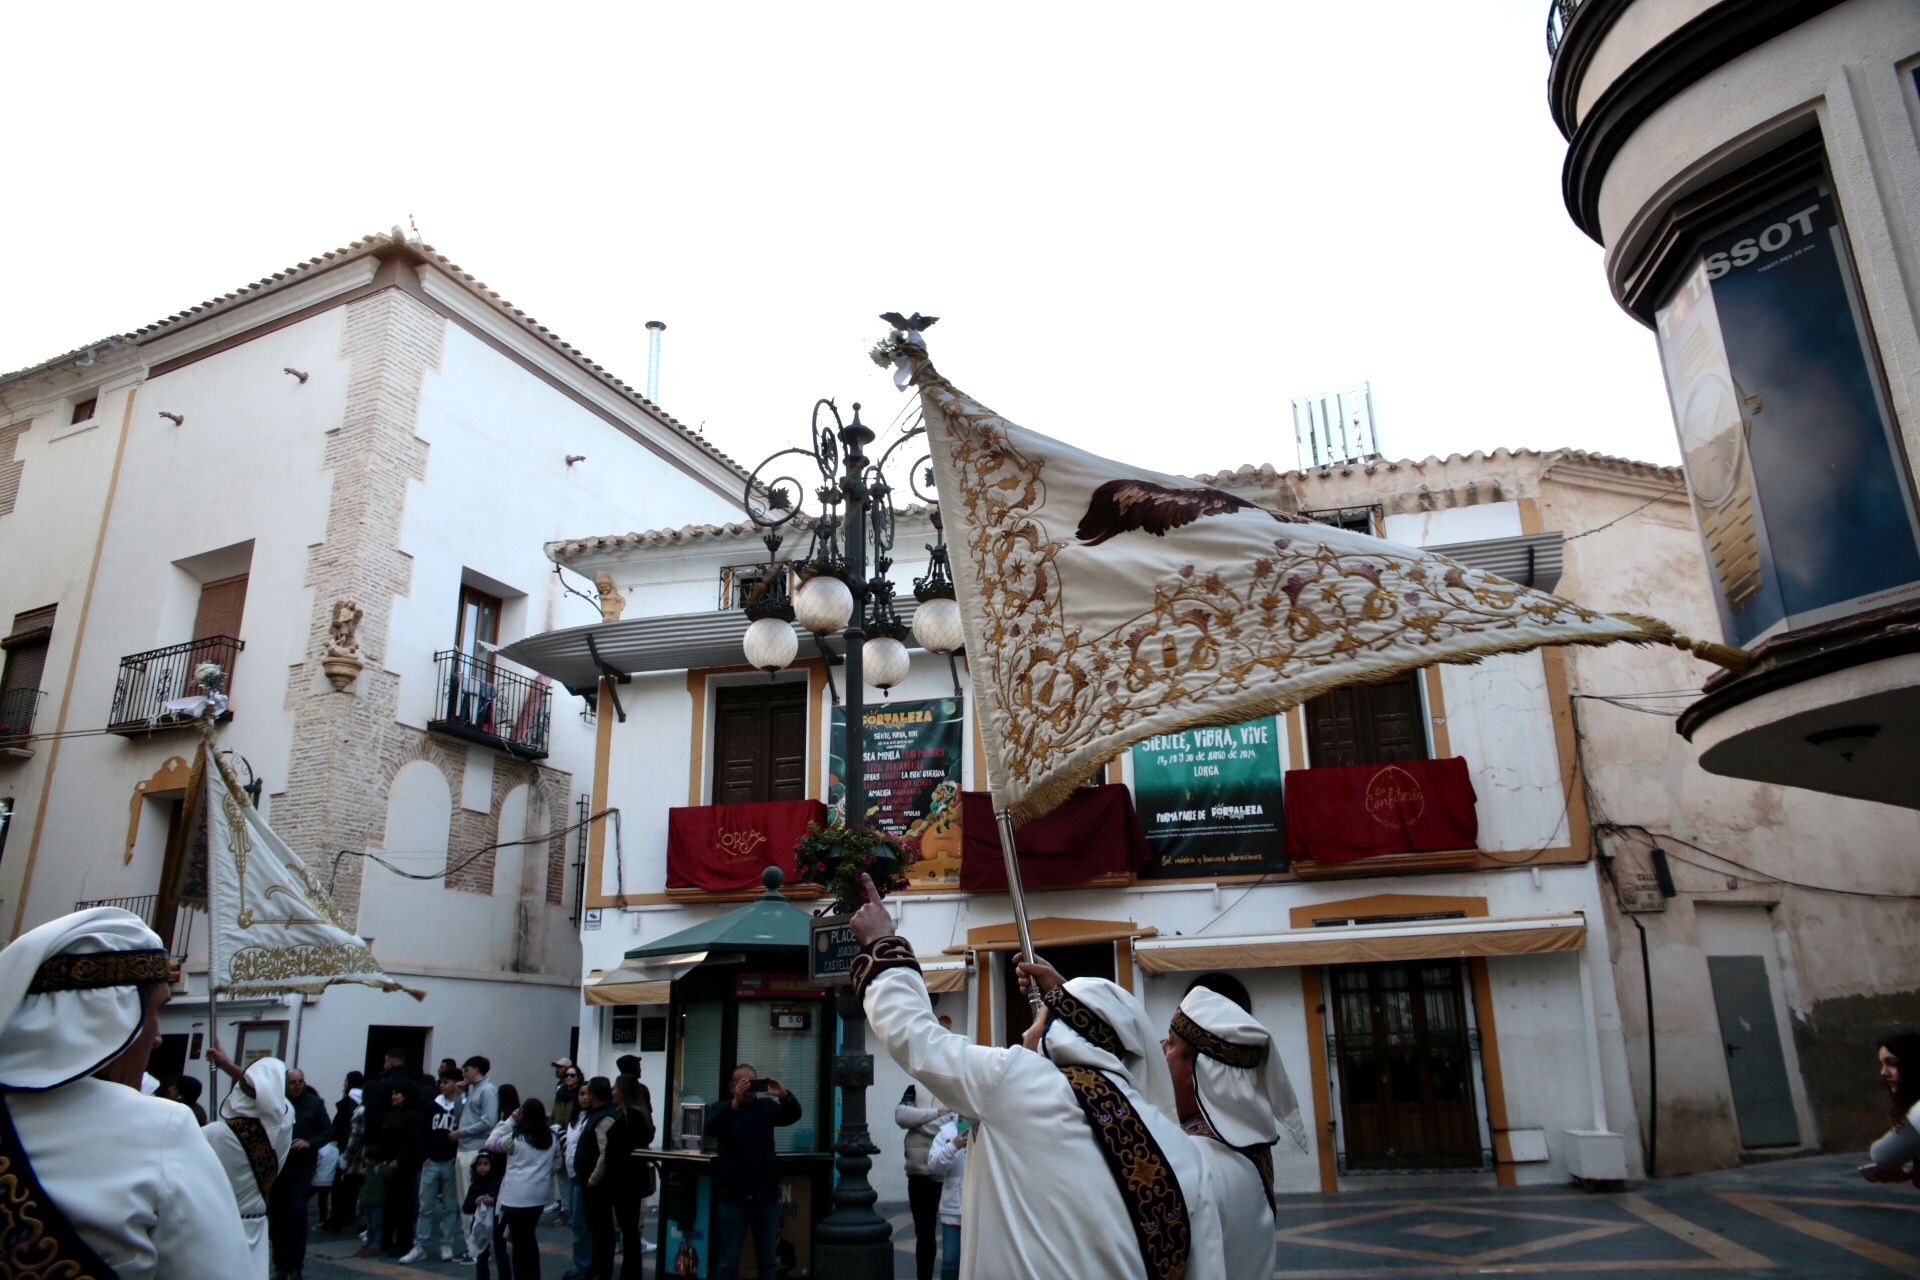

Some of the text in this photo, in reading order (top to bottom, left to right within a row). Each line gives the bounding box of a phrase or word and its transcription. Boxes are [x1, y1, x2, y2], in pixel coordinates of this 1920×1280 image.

[1194, 727, 1238, 749] VIBRA,
[1240, 726, 1268, 745] VIVE
[1193, 765, 1220, 778] LORCA
[831, 929, 857, 944] PLACE
[823, 958, 852, 972] CASTELL
